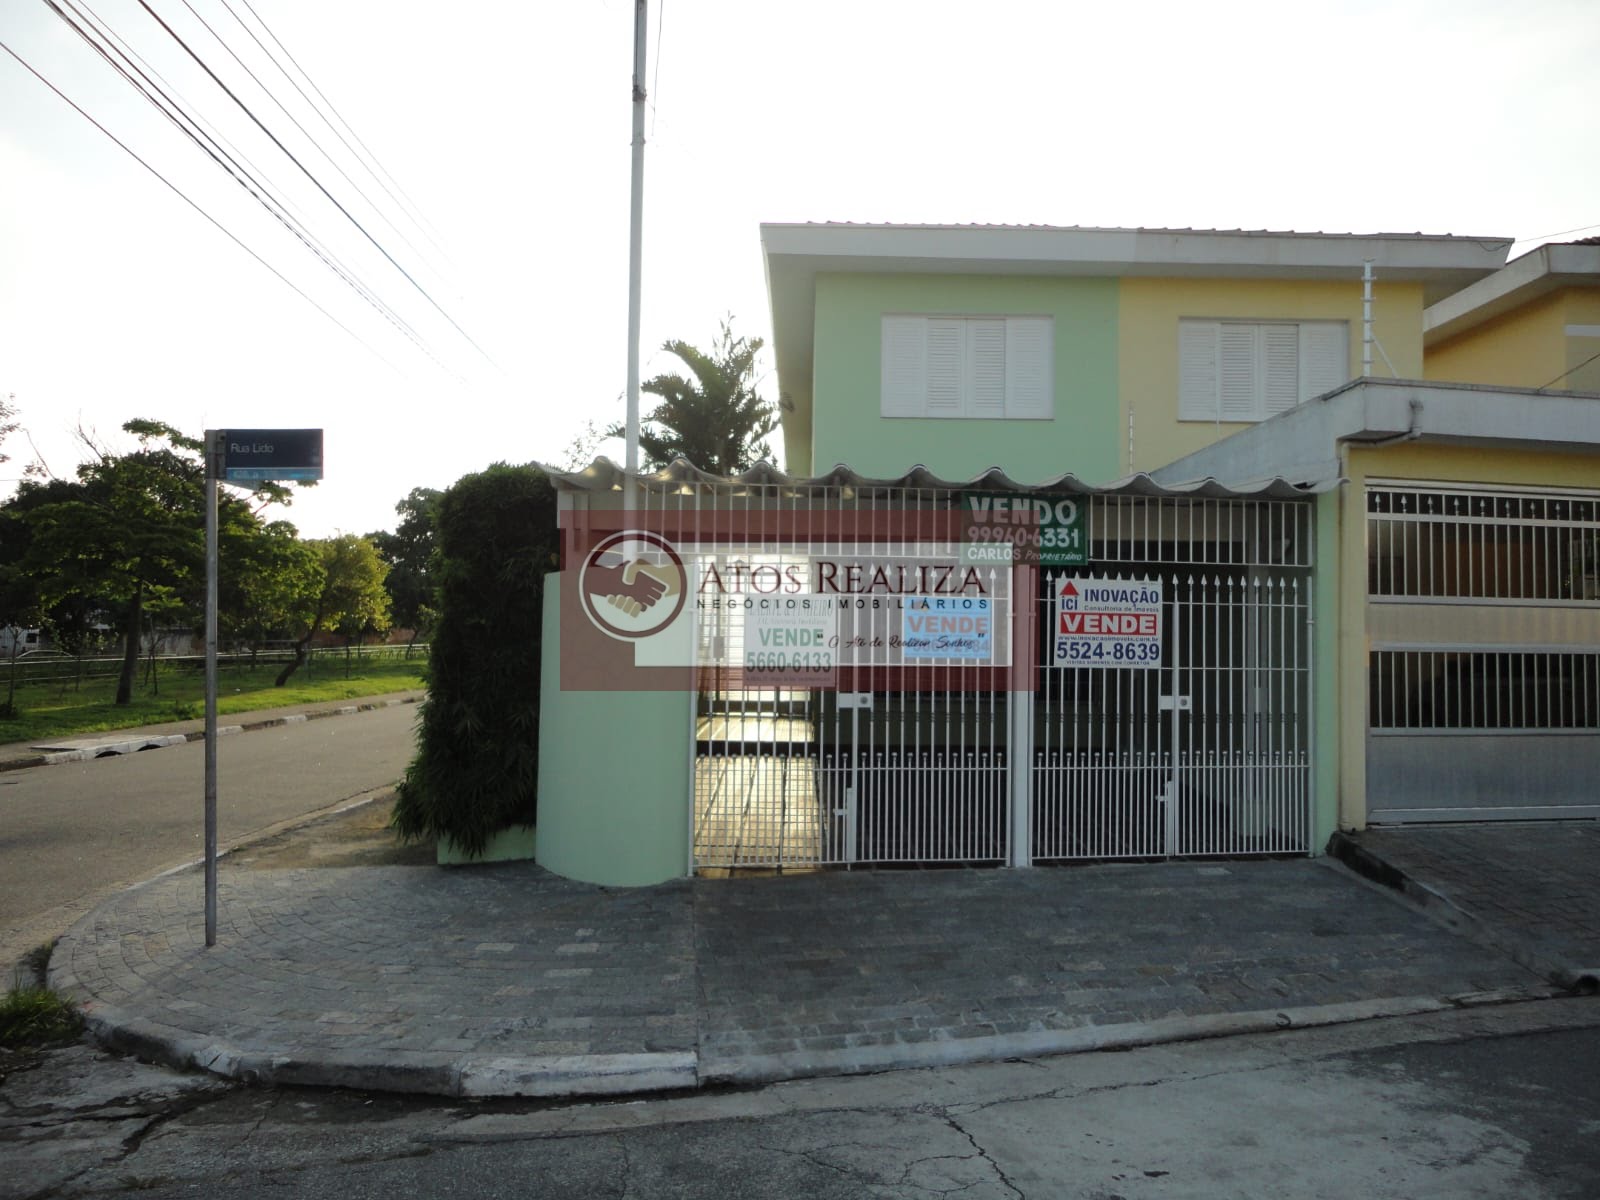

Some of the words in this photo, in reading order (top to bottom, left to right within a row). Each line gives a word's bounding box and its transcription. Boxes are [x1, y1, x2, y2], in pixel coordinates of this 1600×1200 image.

[231, 443, 249, 453] Rua
[253, 443, 274, 453] Lido
[968, 496, 1077, 525] VENDO
[967, 547, 1022, 561] CARLOS
[1084, 587, 1159, 607] INOVAÇÃO
[908, 615, 989, 634] VENDE
[1063, 614, 1155, 634] VENDE
[758, 628, 824, 647] VENDE
[1056, 641, 1160, 661] 5524-8639
[746, 651, 832, 673] 5660-6133
